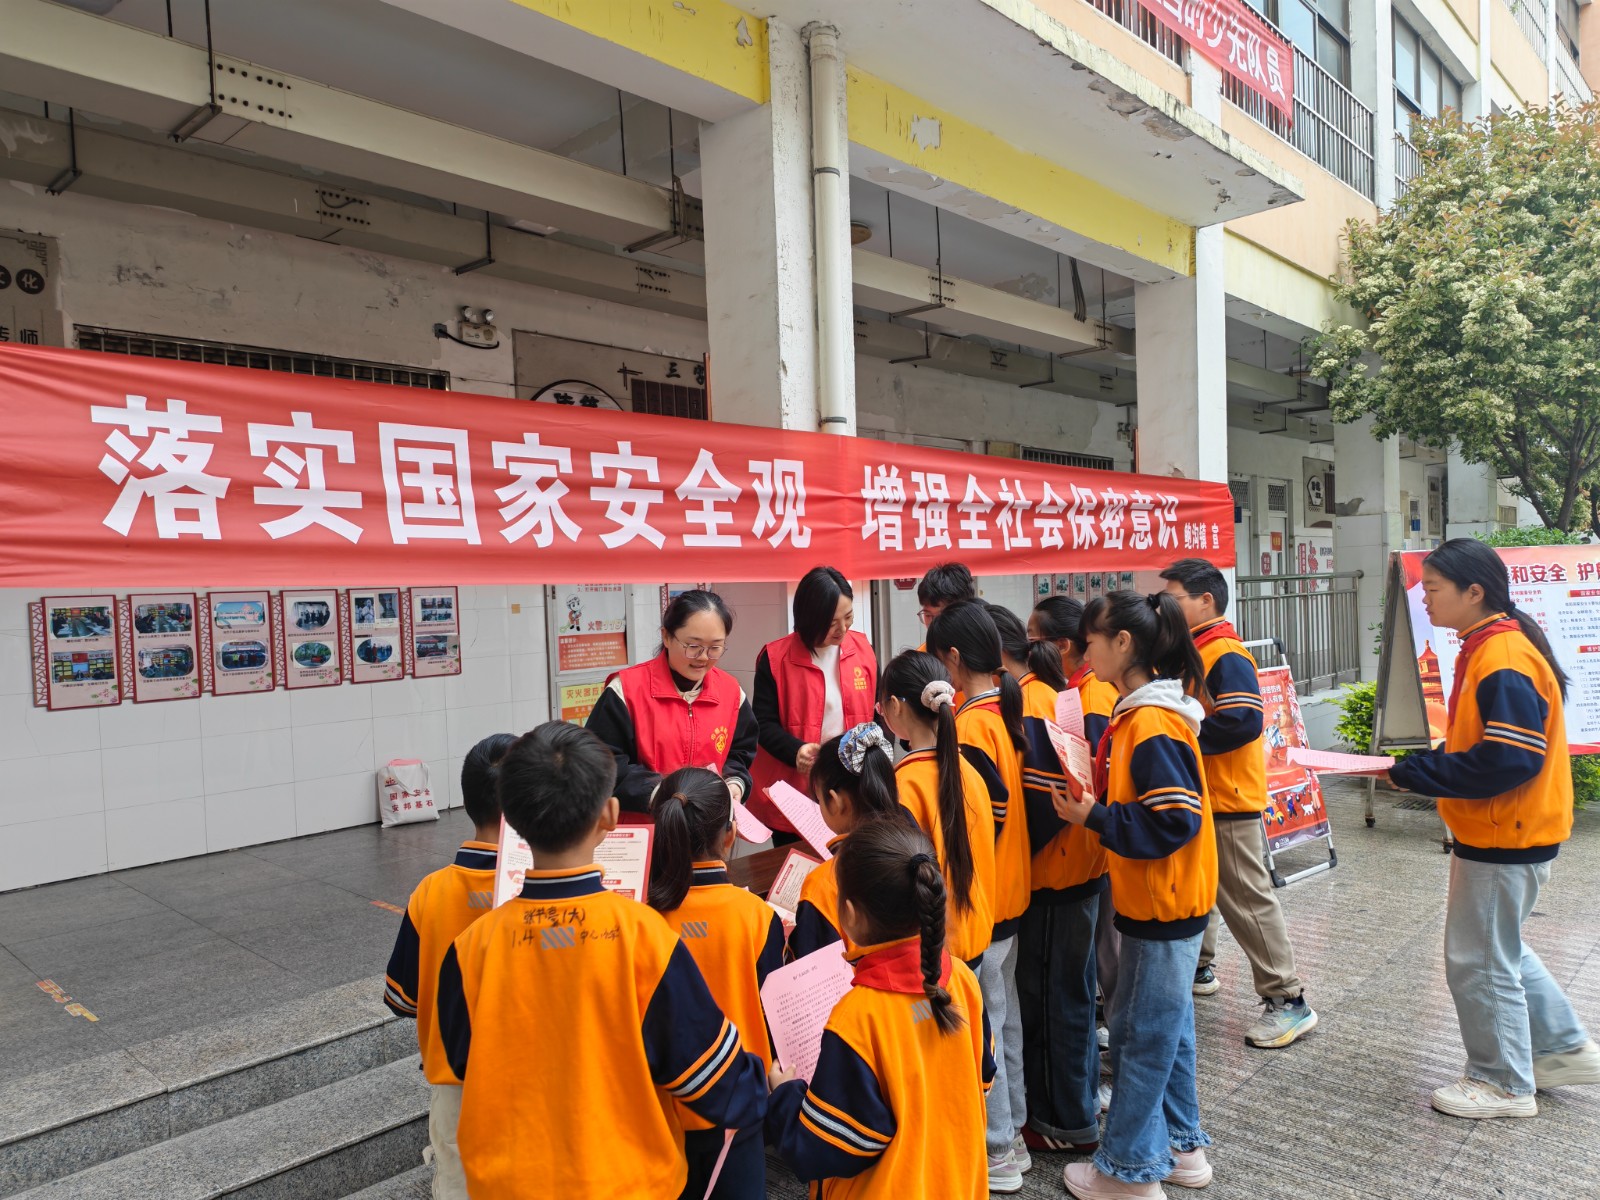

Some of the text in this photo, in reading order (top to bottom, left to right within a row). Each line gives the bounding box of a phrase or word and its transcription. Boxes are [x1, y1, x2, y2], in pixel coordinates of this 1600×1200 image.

[91, 394, 811, 549] 落实国家安全观
[861, 463, 1180, 551] 增强全社会保密意识
[1211, 522, 1220, 550] 宣
[391, 799, 434, 813] 安邦基石
